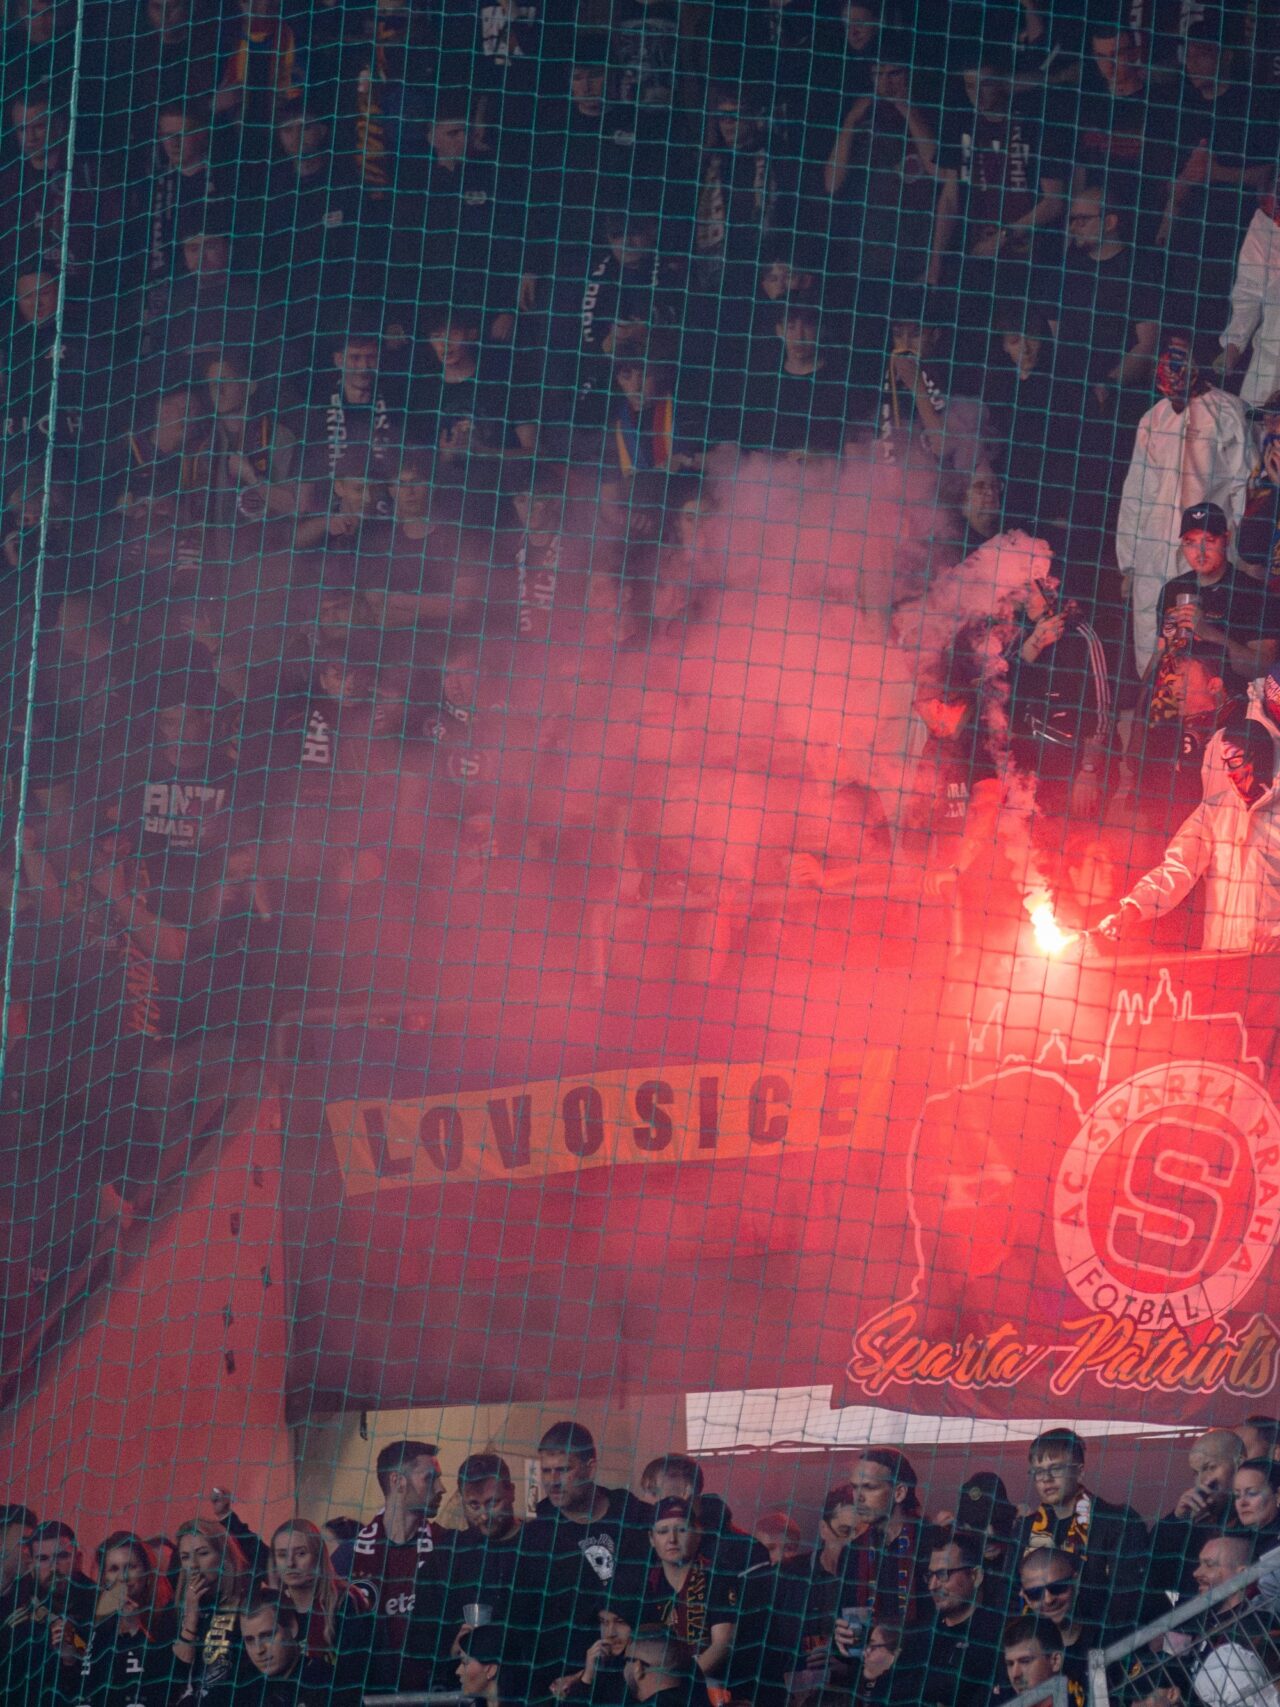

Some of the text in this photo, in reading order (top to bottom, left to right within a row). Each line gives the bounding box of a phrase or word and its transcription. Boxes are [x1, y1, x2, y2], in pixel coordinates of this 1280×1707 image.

[144, 784, 226, 816] ANTI
[363, 1064, 864, 1179] LOVOSICE
[1060, 1073, 1280, 1273] AC SPARTA PRAHA
[1107, 1116, 1241, 1279] S
[1076, 1267, 1200, 1326] FOTBAL
[852, 1304, 1042, 1391] Sparta
[353, 1522, 379, 1555] AC
